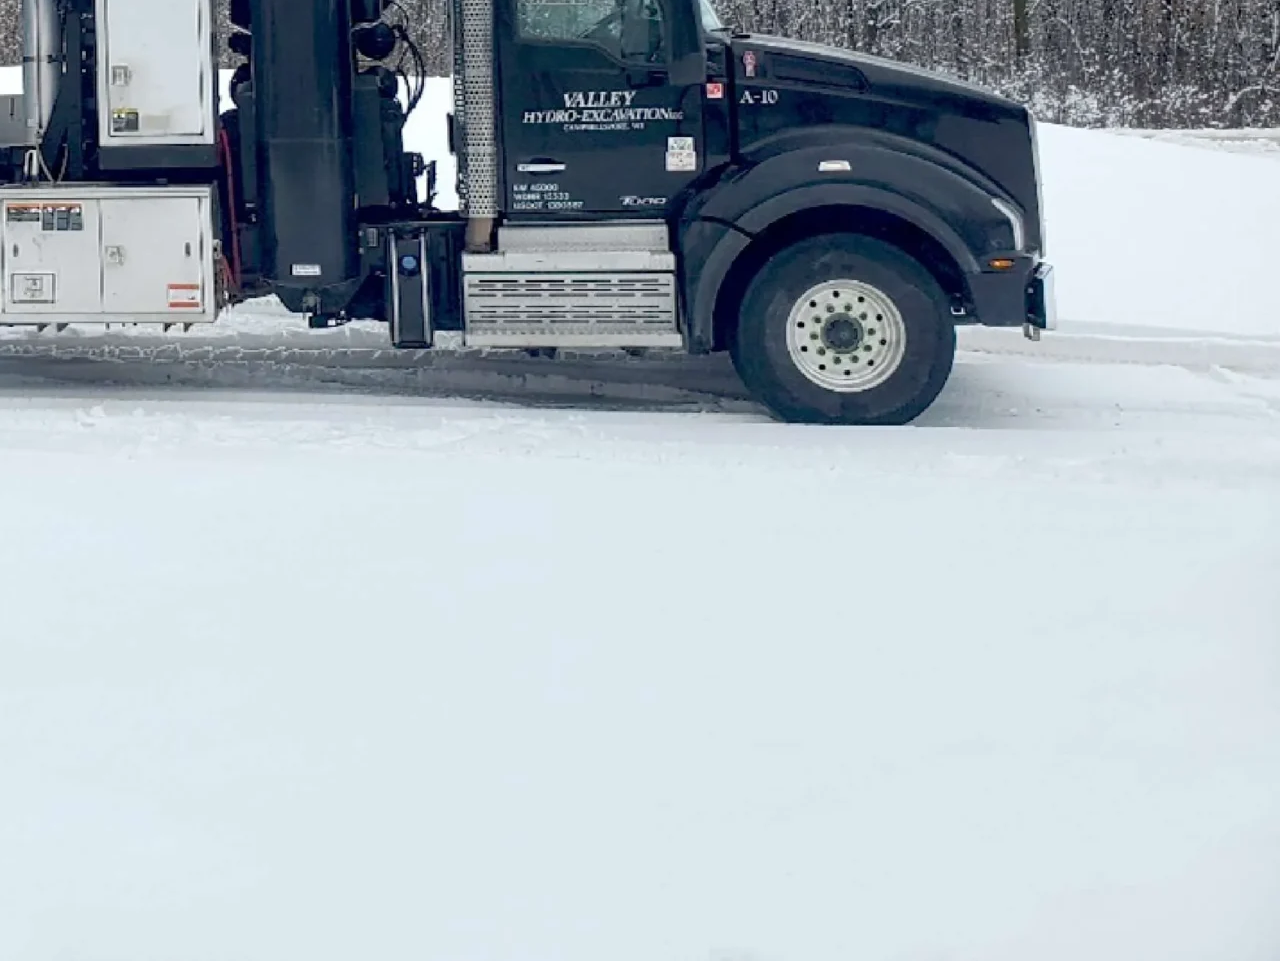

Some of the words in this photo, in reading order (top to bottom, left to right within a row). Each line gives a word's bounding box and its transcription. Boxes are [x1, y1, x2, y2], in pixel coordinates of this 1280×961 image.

[563, 91, 636, 108] VALLEY
[740, 90, 779, 104] A-10
[522, 108, 670, 123] HYDRO-EXCAVATION
